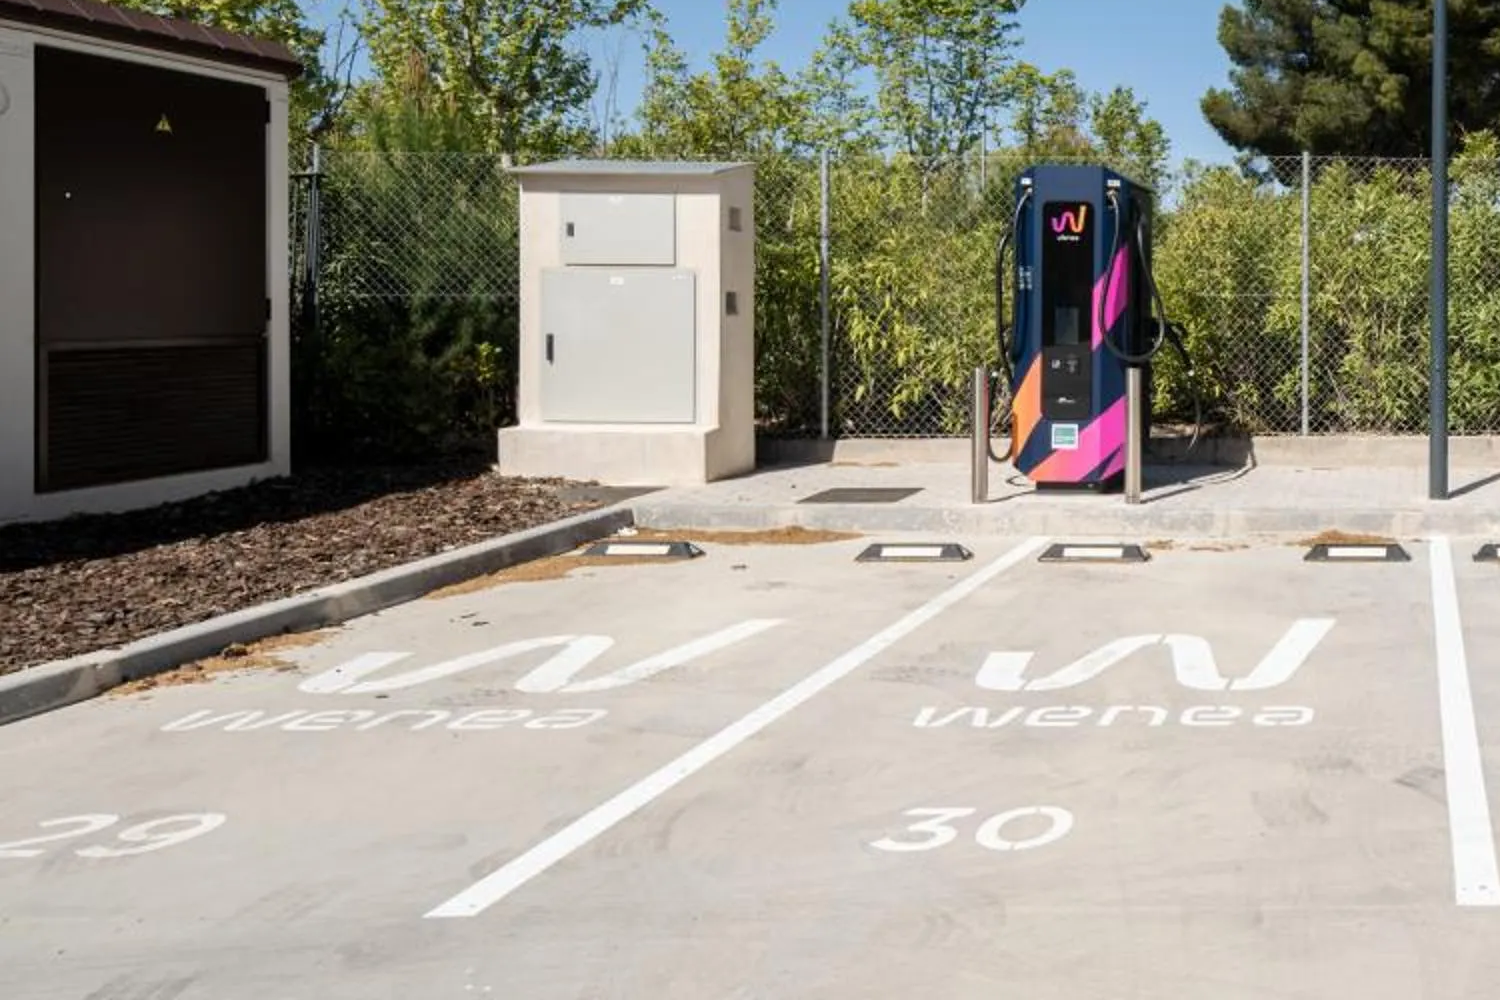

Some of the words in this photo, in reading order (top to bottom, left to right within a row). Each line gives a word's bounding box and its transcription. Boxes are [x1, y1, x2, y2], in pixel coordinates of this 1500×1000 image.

[913, 706, 1315, 728] wenea
[0, 813, 226, 858] 29
[870, 806, 1074, 851] 30
